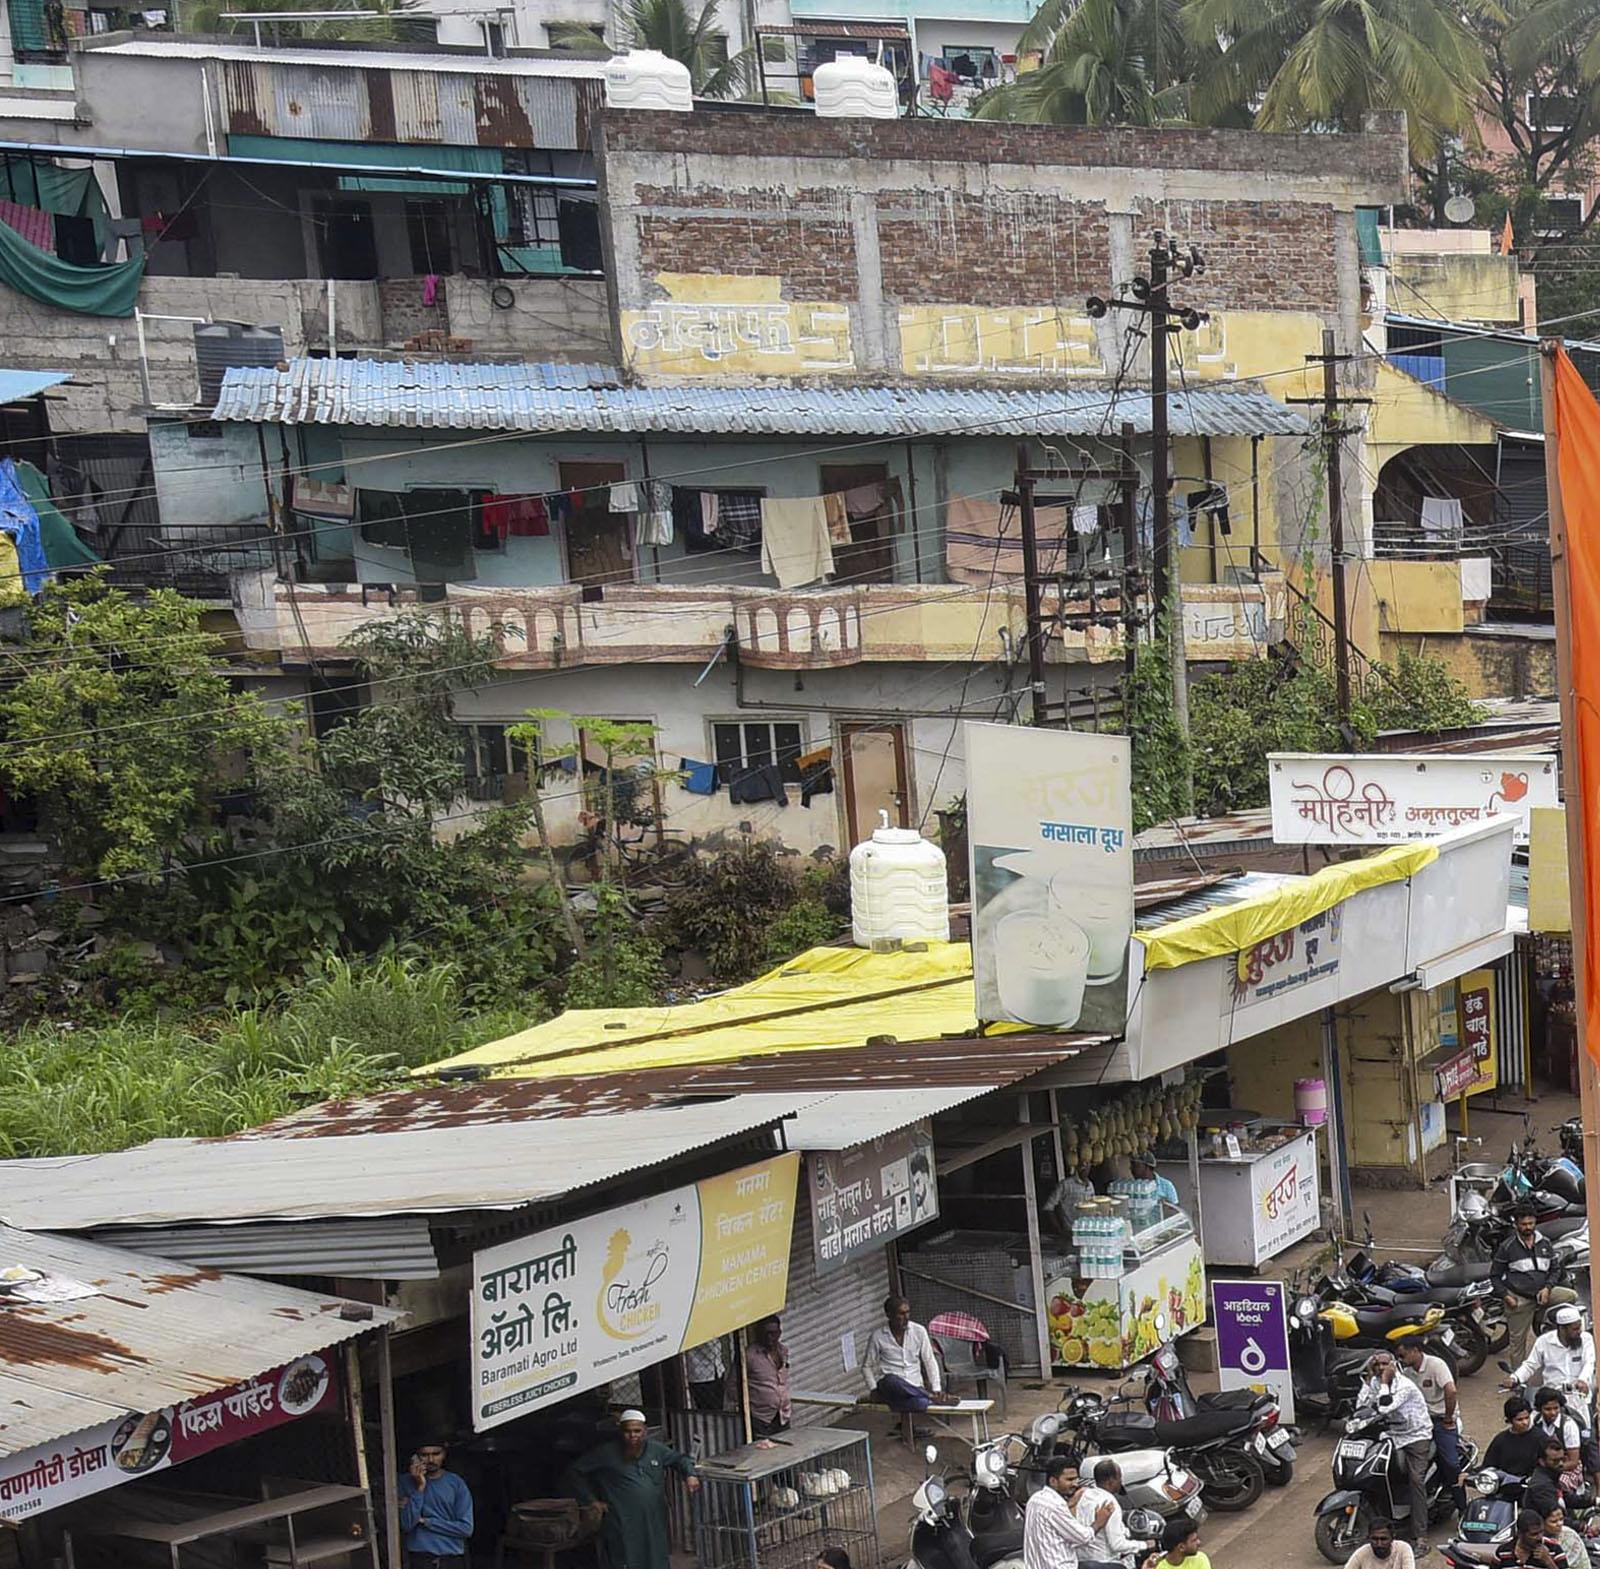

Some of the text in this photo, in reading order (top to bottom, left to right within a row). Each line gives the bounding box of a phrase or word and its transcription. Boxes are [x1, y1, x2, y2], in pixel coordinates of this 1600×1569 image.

[1292, 766, 1481, 837] मोहिनी अमृततुल्य
[1040, 821, 1124, 854] मसाला दूध
[864, 1181, 874, 1201] &
[481, 1233, 577, 1303] बारामती
[698, 1261, 787, 1303] CHICKEN CENTER
[541, 1292, 579, 1339] लि.
[481, 1356, 530, 1386] Baramati
[532, 1346, 558, 1370] Agro
[559, 1337, 578, 1357] Ltd
[67, 1444, 107, 1478] डोसा
